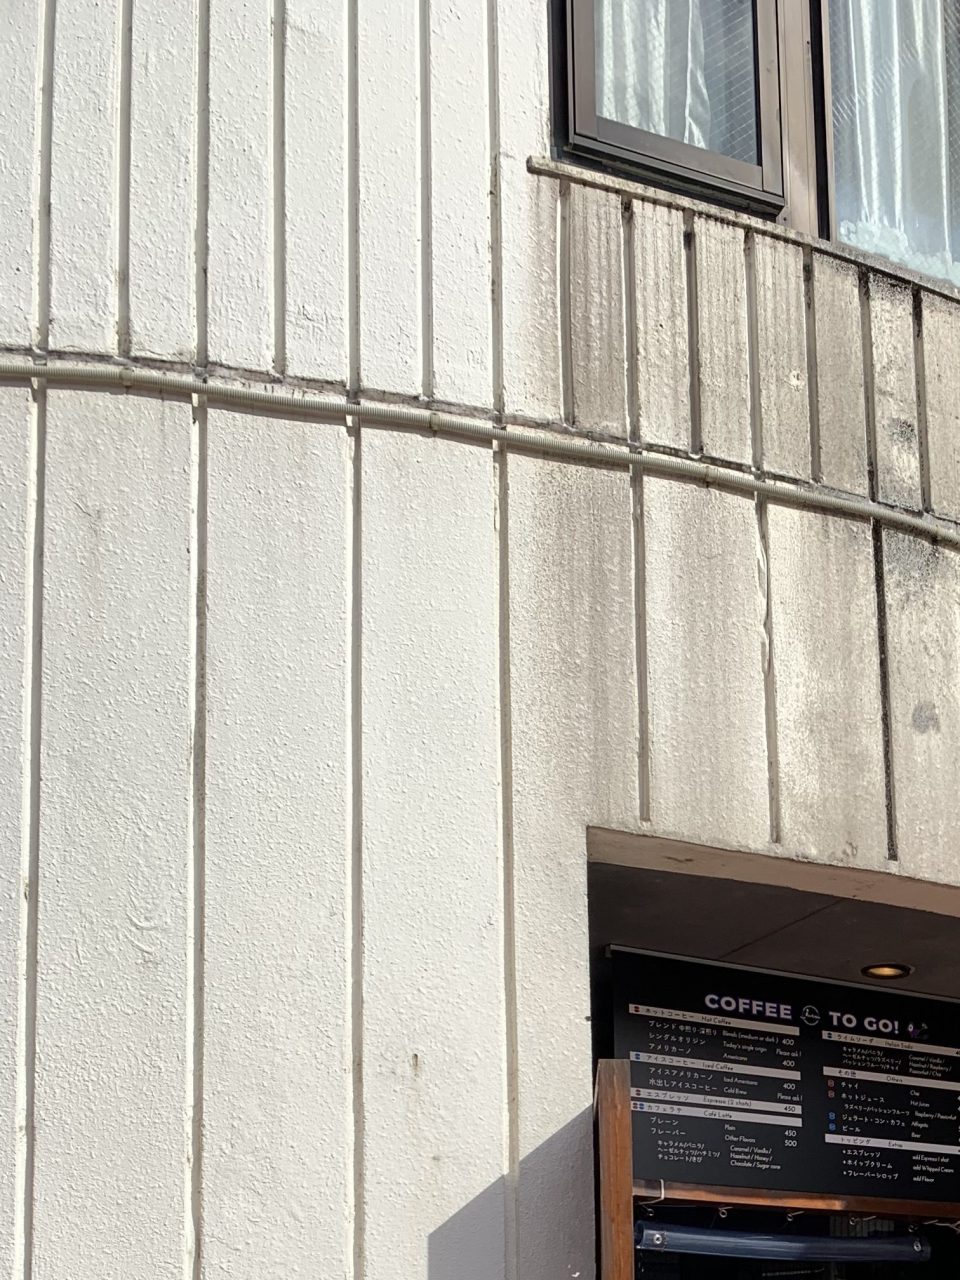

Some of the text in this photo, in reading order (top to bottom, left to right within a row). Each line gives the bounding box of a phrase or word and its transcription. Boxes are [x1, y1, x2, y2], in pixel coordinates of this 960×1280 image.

[645, 1007, 694, 1019] ホットコーヒー
[713, 1017, 731, 1026] Coffee
[705, 994, 792, 1019] COFFEE
[829, 1011, 857, 1028] TO
[864, 1017, 899, 1034] GO!
[649, 1020, 676, 1031] ブレンド
[782, 1038, 794, 1046] 400
[649, 1032, 706, 1045] シングルオリジン
[649, 1043, 691, 1054] アメリカーノ
[646, 1055, 696, 1066] アイスコーヒー
[715, 1063, 734, 1071] Coffee
[649, 1068, 714, 1081] アイスアメリカーノ
[783, 1082, 795, 1090] 400
[838, 1069, 857, 1078] その他
[649, 1079, 718, 1092] 水出しアイスコーヒー
[841, 1081, 859, 1089] チャイ
[646, 1091, 689, 1102] エスプレッソ
[841, 1093, 885, 1103] ホットジュース
[647, 1104, 682, 1114] カフェラテ
[650, 1127, 686, 1136] フレーバー
[842, 1125, 861, 1133] ビール
[841, 1137, 871, 1146] トッピング
